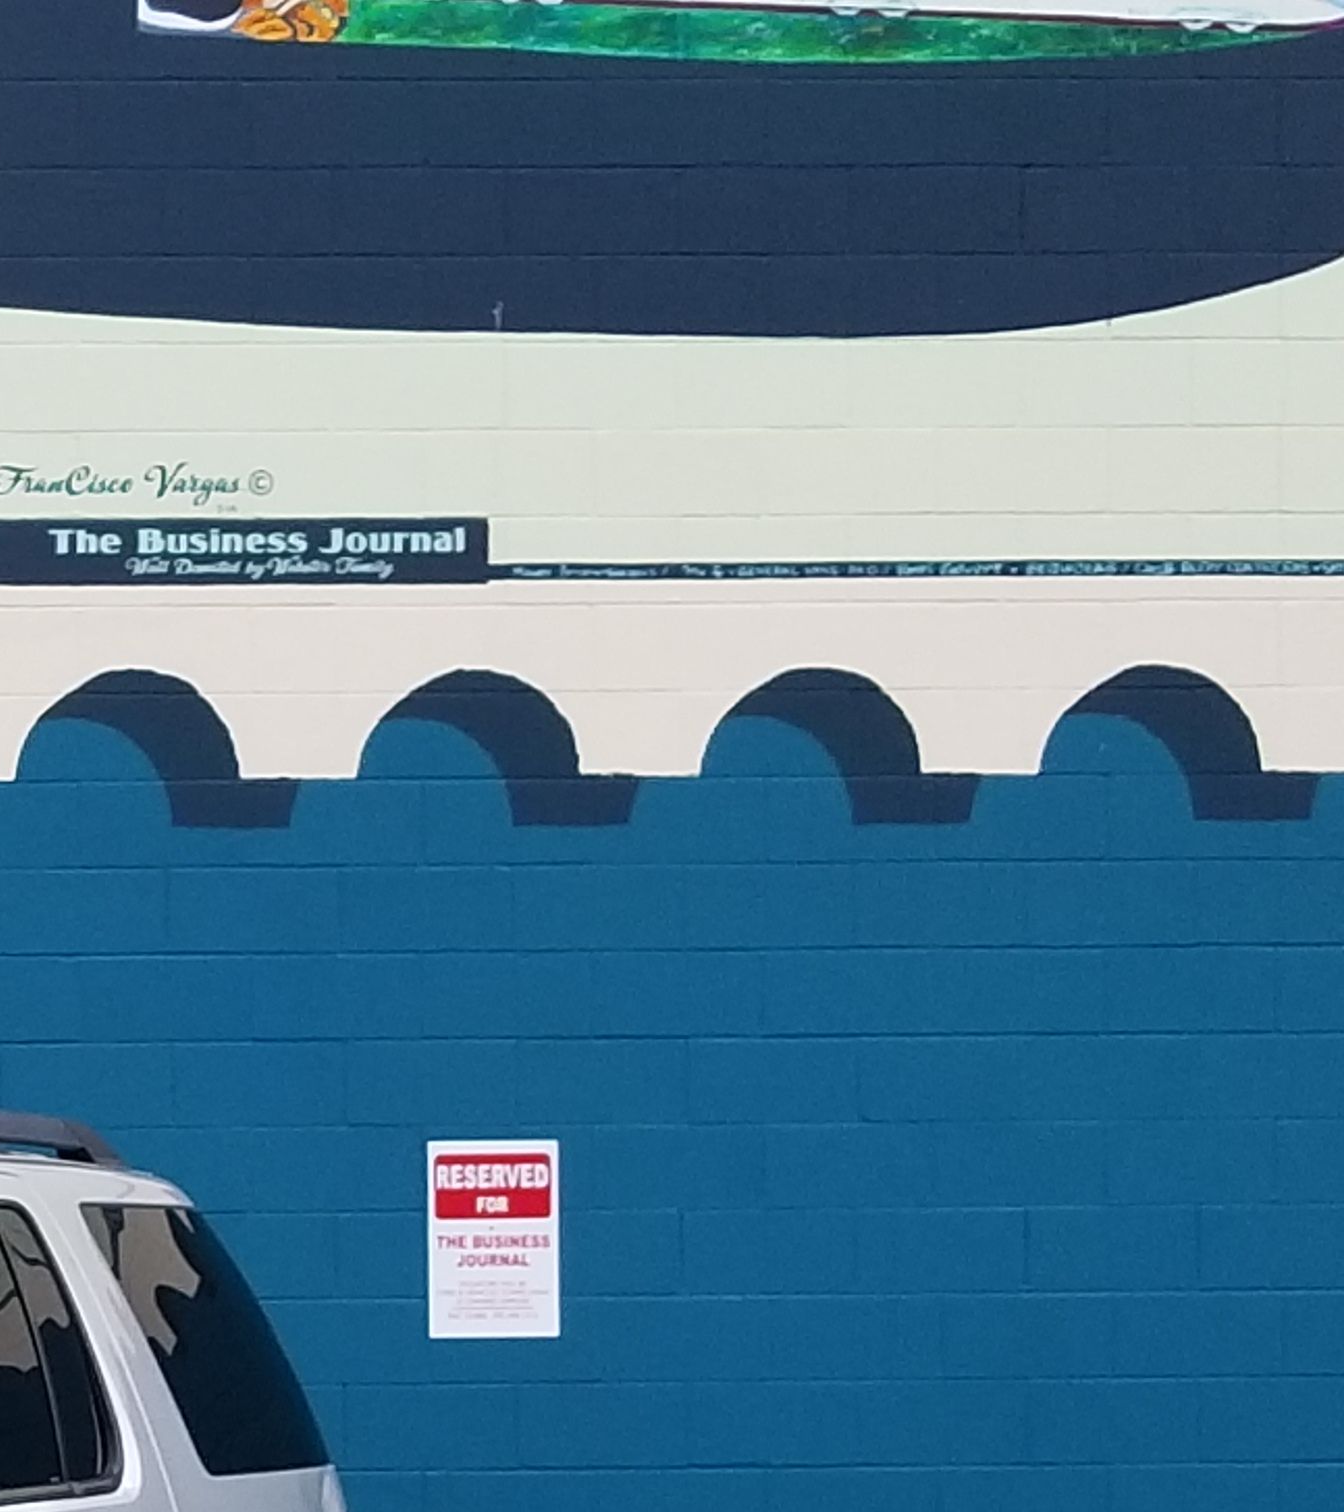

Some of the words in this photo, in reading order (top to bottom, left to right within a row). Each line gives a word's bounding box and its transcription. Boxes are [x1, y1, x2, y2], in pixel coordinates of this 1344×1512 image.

[143, 462, 239, 506] Vargas
[49, 529, 122, 554] The
[137, 528, 308, 553] Business
[319, 527, 466, 554] Journal
[437, 1164, 548, 1189] RESERVED
[476, 1197, 508, 1213] FOR
[437, 1236, 467, 1249] THE
[473, 1235, 550, 1248] BUSINESS
[457, 1254, 529, 1267] JOURNAL
